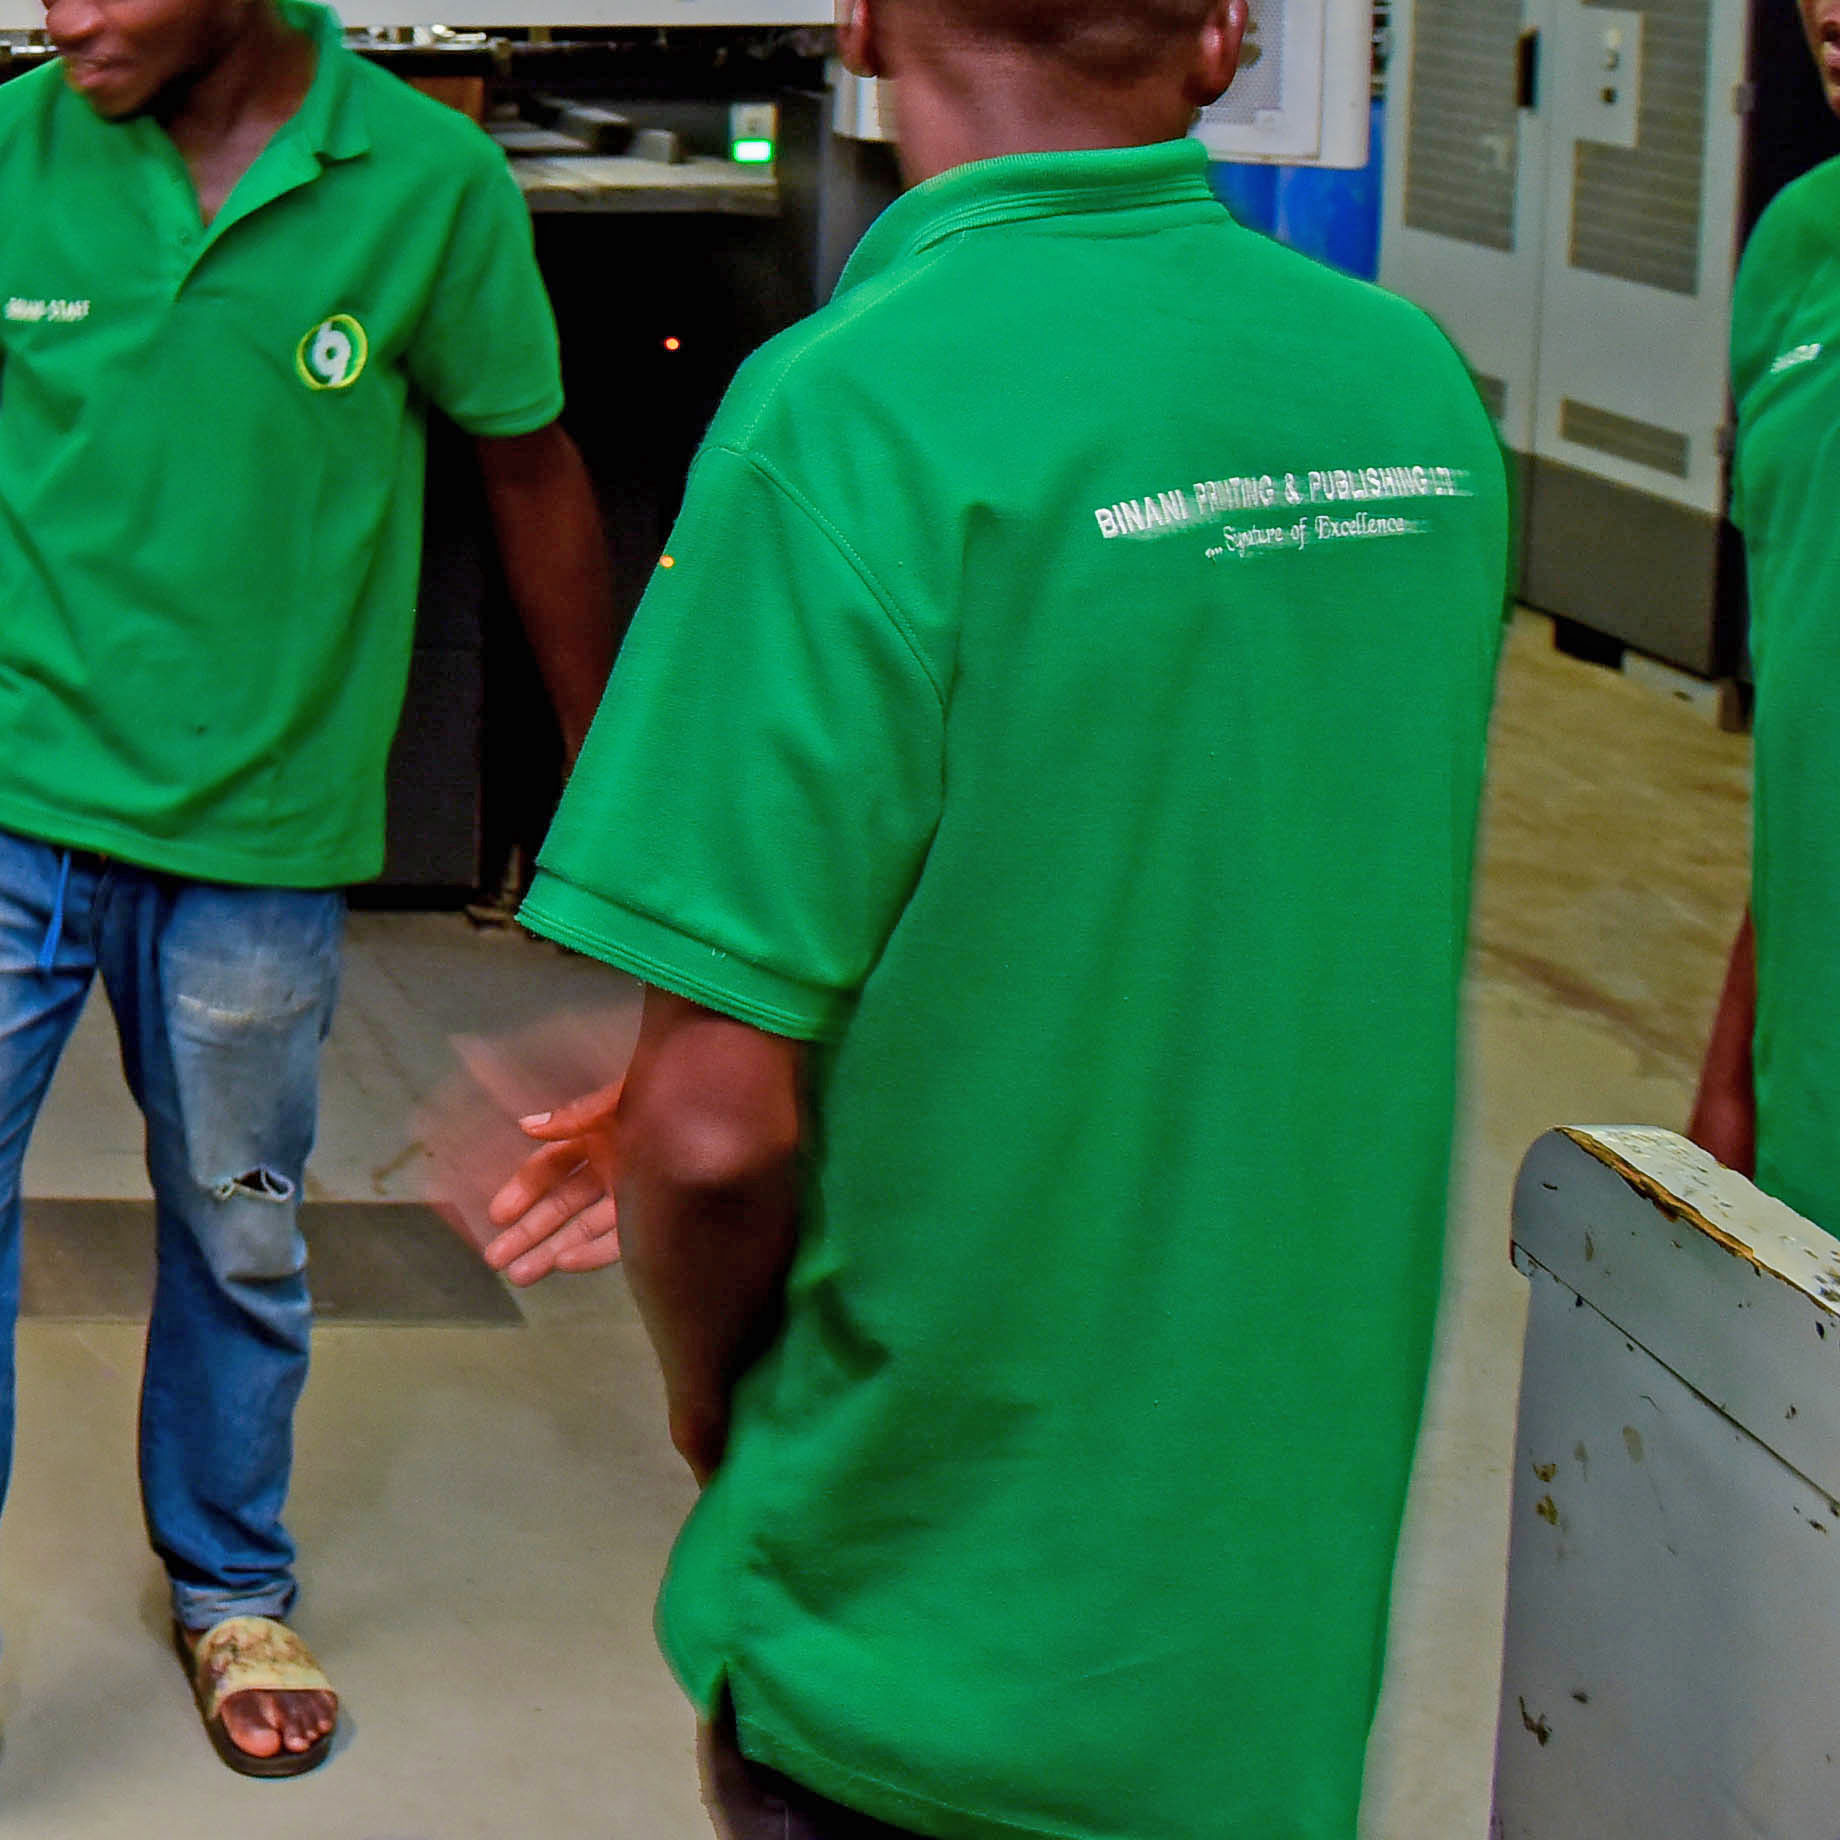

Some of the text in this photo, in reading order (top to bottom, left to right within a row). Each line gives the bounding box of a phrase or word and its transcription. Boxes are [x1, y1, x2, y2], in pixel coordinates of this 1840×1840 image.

[1094, 489, 1189, 539] BINANI
[1193, 474, 1275, 515] PRINTING
[1284, 472, 1303, 505] &
[1308, 466, 1428, 502] PUBLISHING
[1290, 516, 1308, 551] of
[1314, 511, 1406, 539] Excellence
